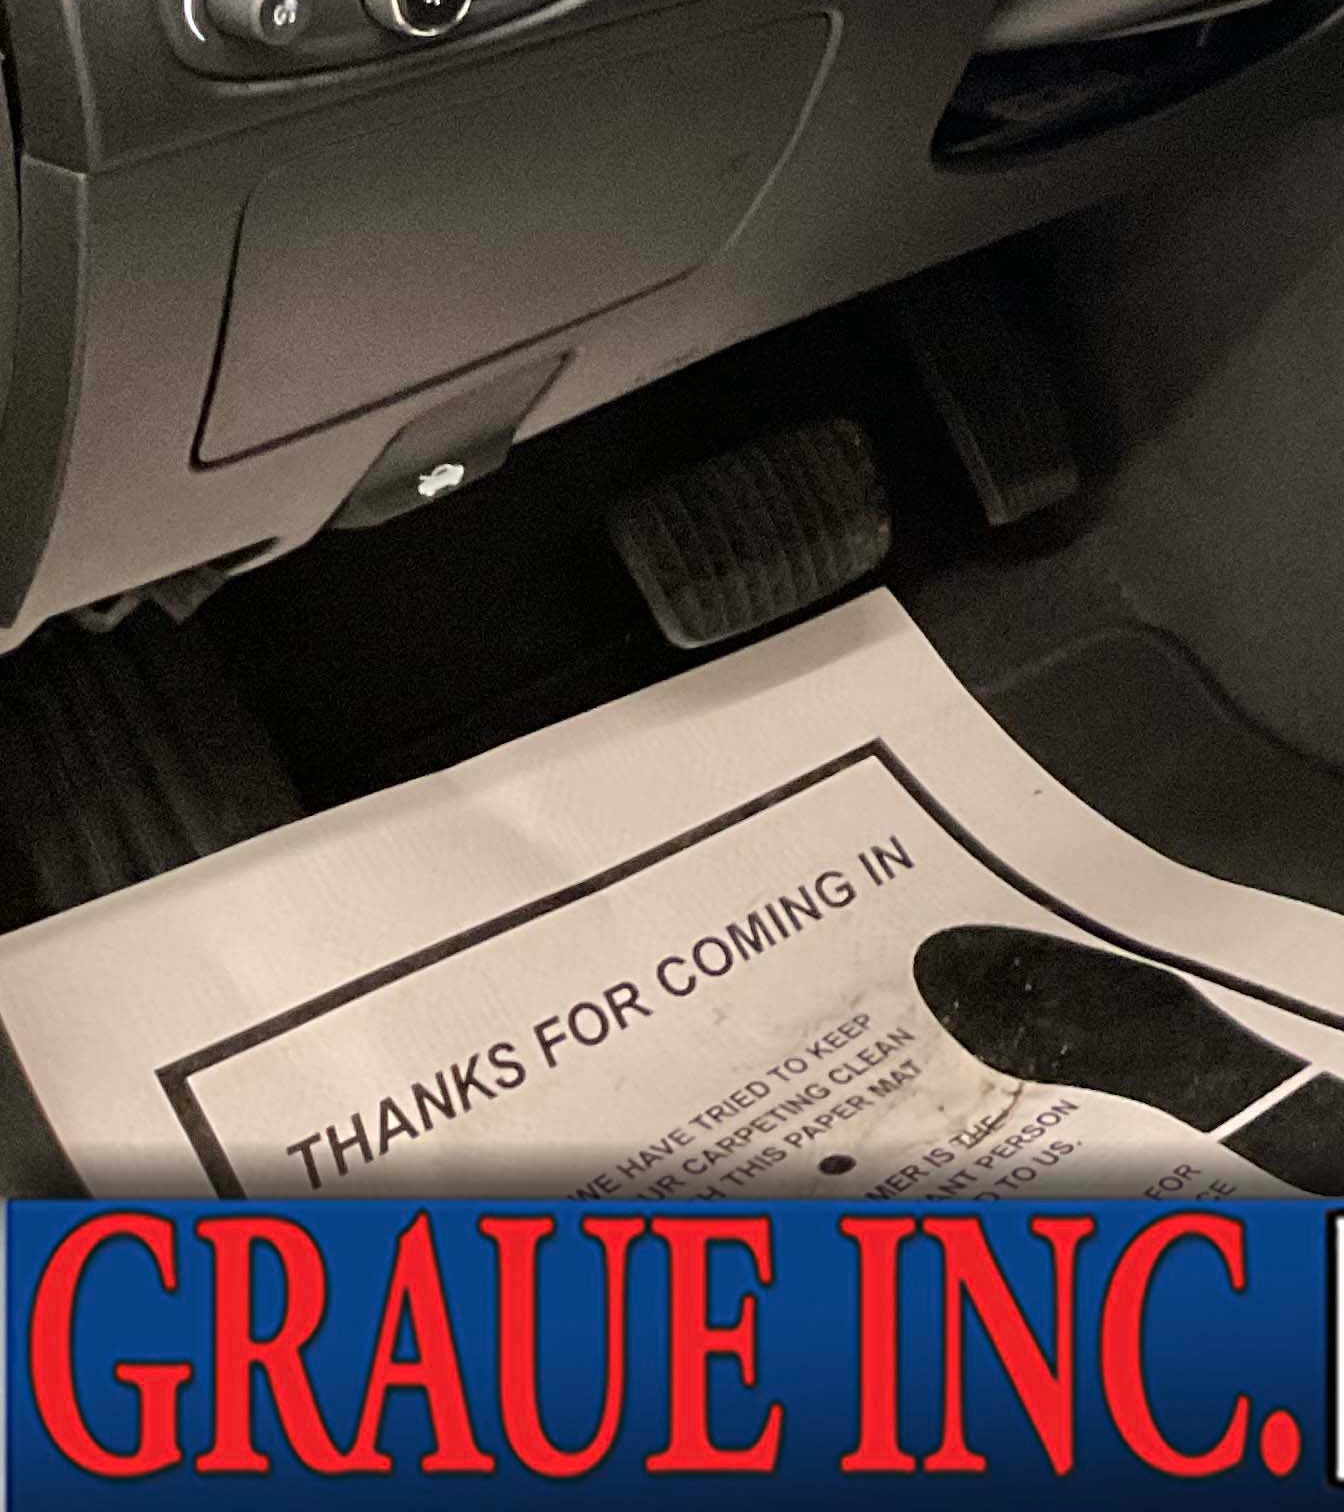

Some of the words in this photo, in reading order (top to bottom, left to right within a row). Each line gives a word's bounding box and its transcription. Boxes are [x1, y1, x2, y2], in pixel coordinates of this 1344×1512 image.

[287, 1041, 526, 1190] THANKS
[534, 981, 653, 1068] FOR
[656, 870, 856, 996] COMING
[857, 836, 916, 886] IN
[568, 1172, 621, 1200] WE
[616, 1128, 696, 1180] HAVE
[688, 1080, 771, 1131] TRIED
[766, 1056, 809, 1084] TO
[806, 1013, 872, 1061] KEEP
[637, 1174, 687, 1200] UR
[682, 1082, 831, 1177] CARPETING
[828, 1027, 916, 1086] CLEAN
[720, 1145, 787, 1188] THIS
[783, 1094, 873, 1149] PAPER
[867, 1058, 923, 1099] MAT
[922, 1146, 955, 1169] IS
[950, 1115, 1003, 1150] THE
[976, 1098, 1080, 1169] PERSON
[995, 1165, 1037, 1190] TO
[1143, 1162, 1202, 1200] FOR
